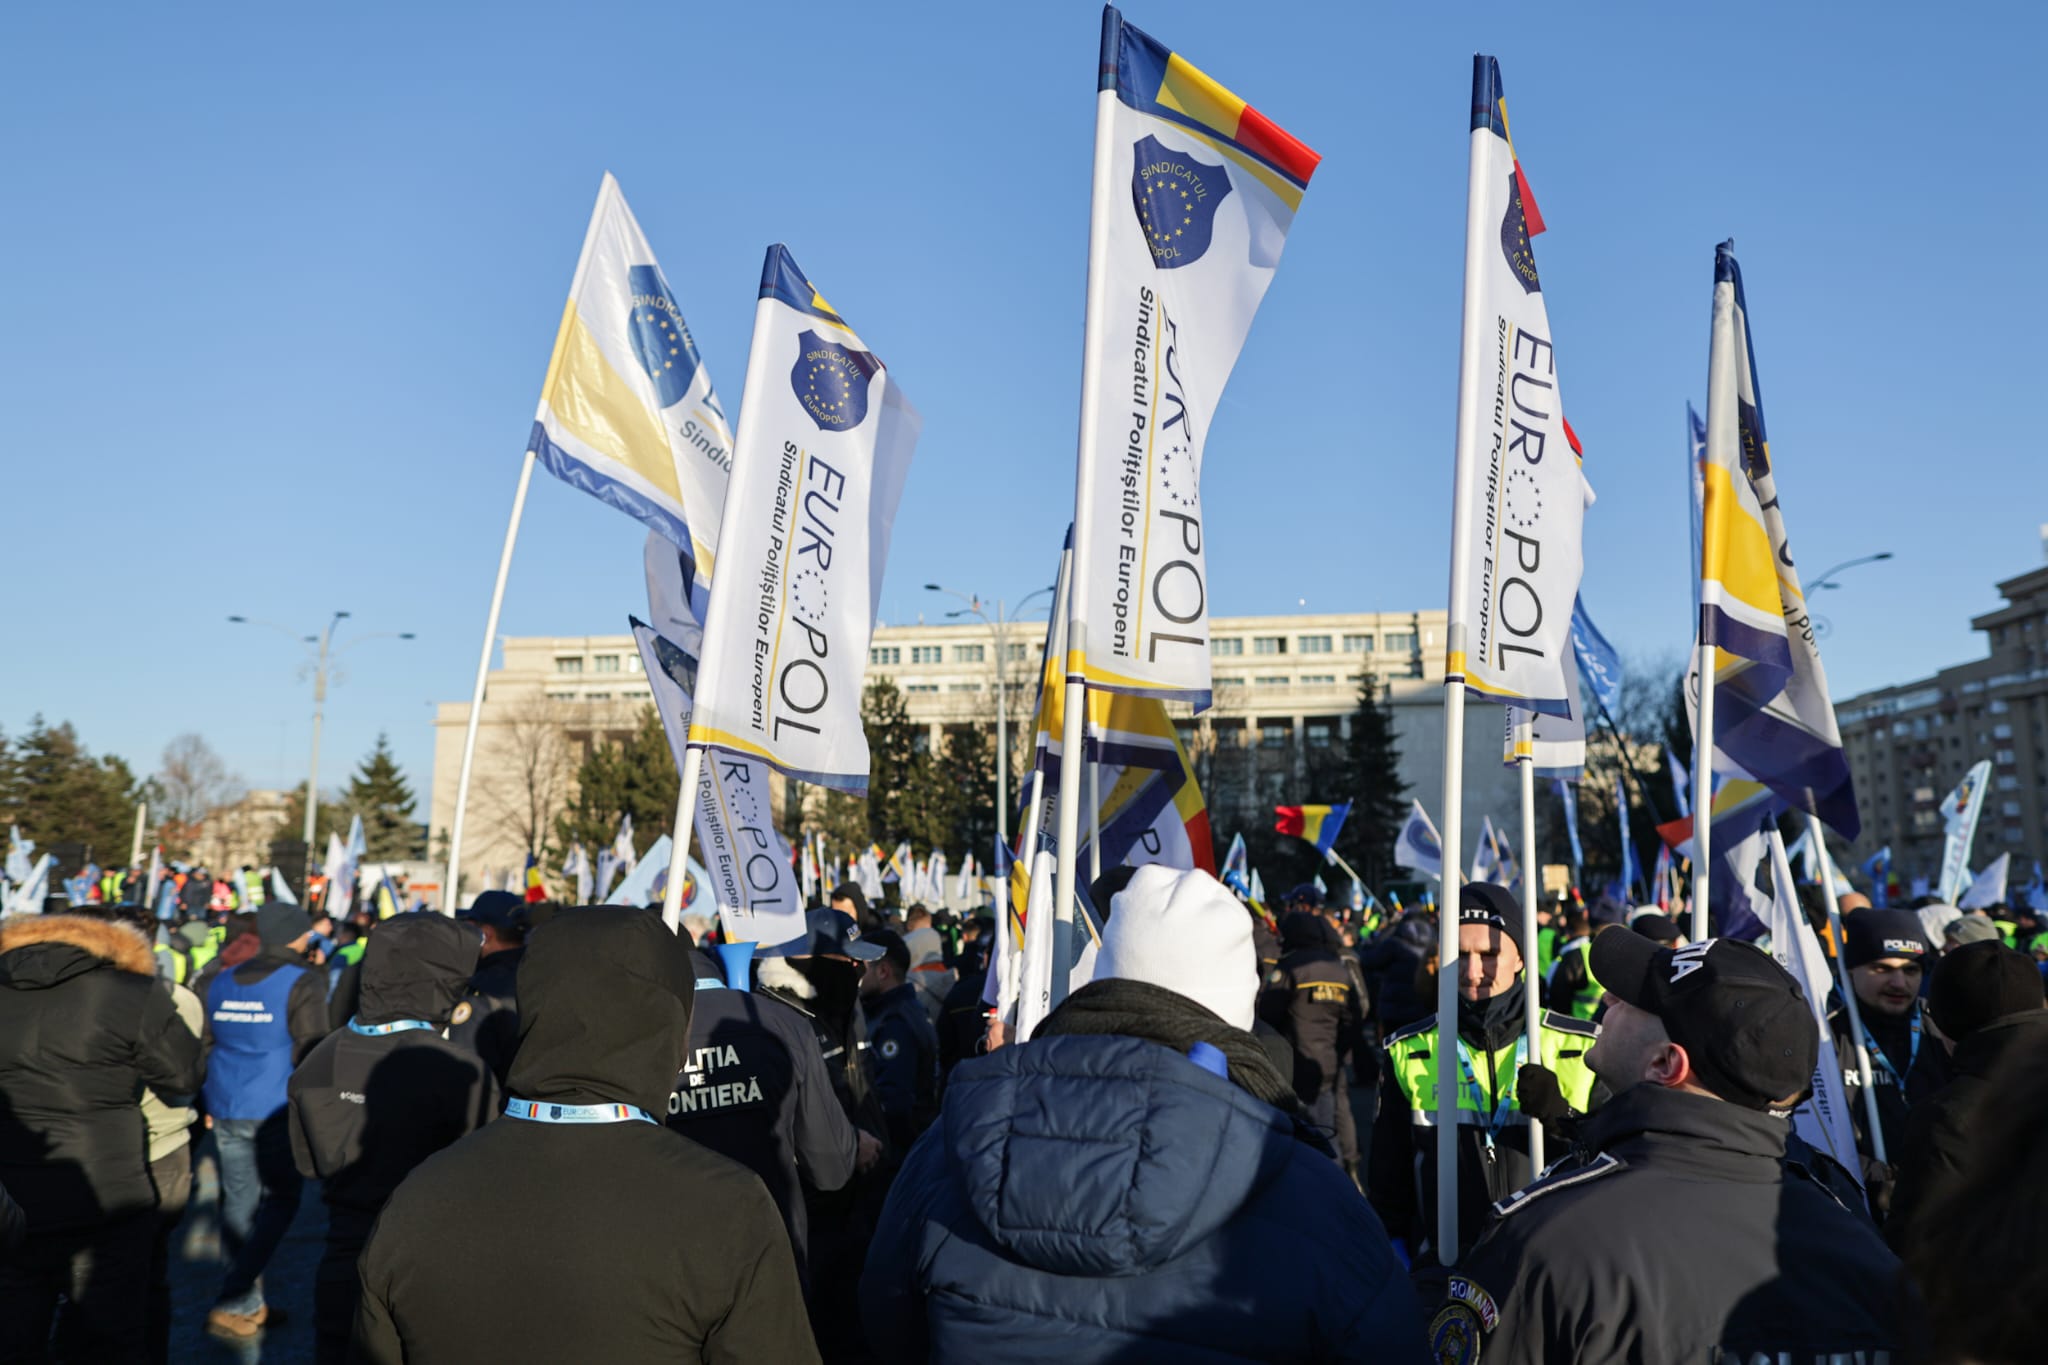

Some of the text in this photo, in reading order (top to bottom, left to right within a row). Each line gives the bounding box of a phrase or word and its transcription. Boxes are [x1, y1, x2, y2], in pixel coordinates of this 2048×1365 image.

[1140, 161, 1208, 203] SINDICATUL
[1512, 251, 1537, 282] EUROP
[806, 350, 861, 381] SINDICATUL
[1133, 286, 1153, 407] Sindicatul
[1494, 314, 1506, 428] Sindicatul
[803, 394, 845, 424] EUROPOL
[679, 420, 732, 473] Sindic
[772, 440, 797, 533] Sindicatul
[1112, 544, 1136, 657] Europeni
[1479, 556, 1493, 664] Europeni
[751, 638, 769, 732] Europeni
[718, 854, 743, 918] Europeni
[1459, 908, 1506, 926] ITIA
[680, 1044, 741, 1075] LIȚIA
[689, 1073, 706, 1087] DE
[1844, 1069, 1895, 1086] POTIA
[667, 1076, 764, 1115] ONTIERĂ
